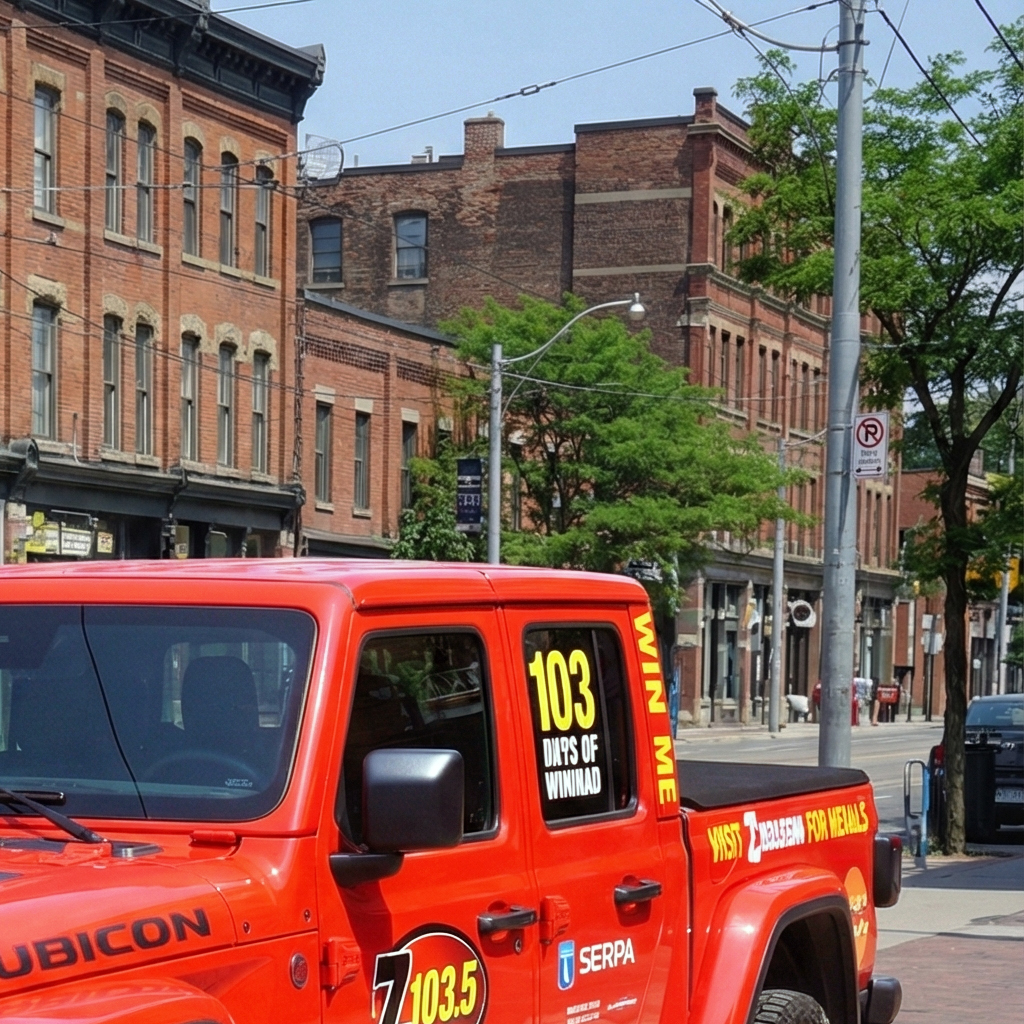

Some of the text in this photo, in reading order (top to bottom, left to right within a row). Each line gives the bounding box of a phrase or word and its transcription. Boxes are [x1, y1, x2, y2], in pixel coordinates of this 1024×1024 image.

[529, 649, 596, 732] 103
[633, 611, 677, 805] WIN ME
[581, 733, 599, 764] OF
[579, 937, 636, 975] SERPA
